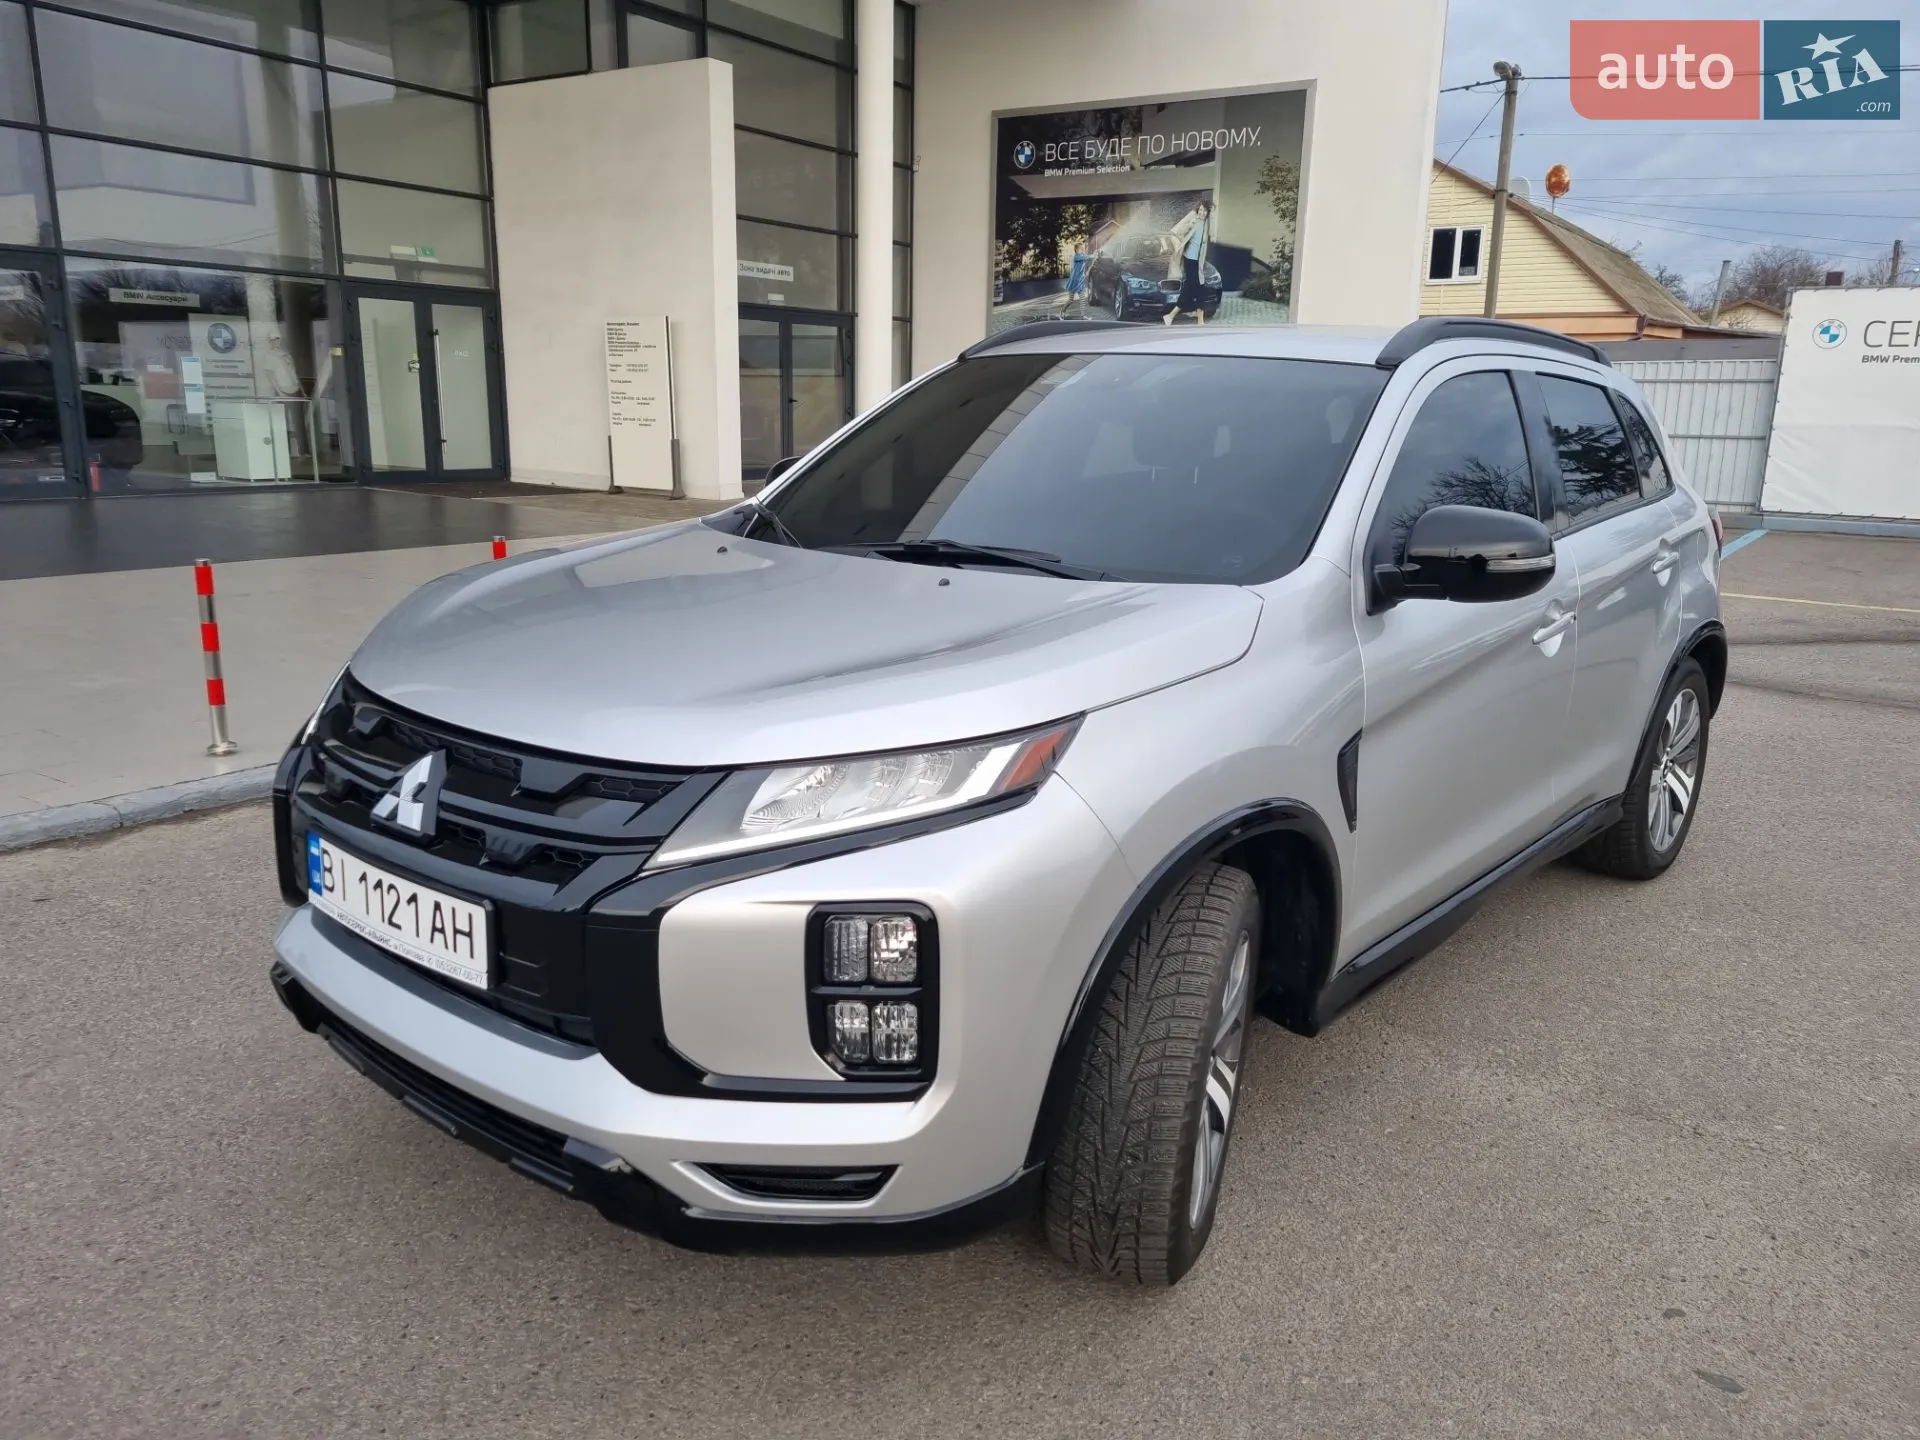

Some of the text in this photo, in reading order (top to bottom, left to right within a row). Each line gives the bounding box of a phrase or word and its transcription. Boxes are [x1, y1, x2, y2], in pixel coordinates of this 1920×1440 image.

[1045, 126, 1261, 162] ВСЕ БУДЕ ПО НОВОМУ.
[1044, 164, 1131, 177] BMW Premium Selection
[123, 291, 144, 299] BMW
[1861, 354, 1890, 363] BMW
[322, 847, 475, 959] BI 1121 AH
